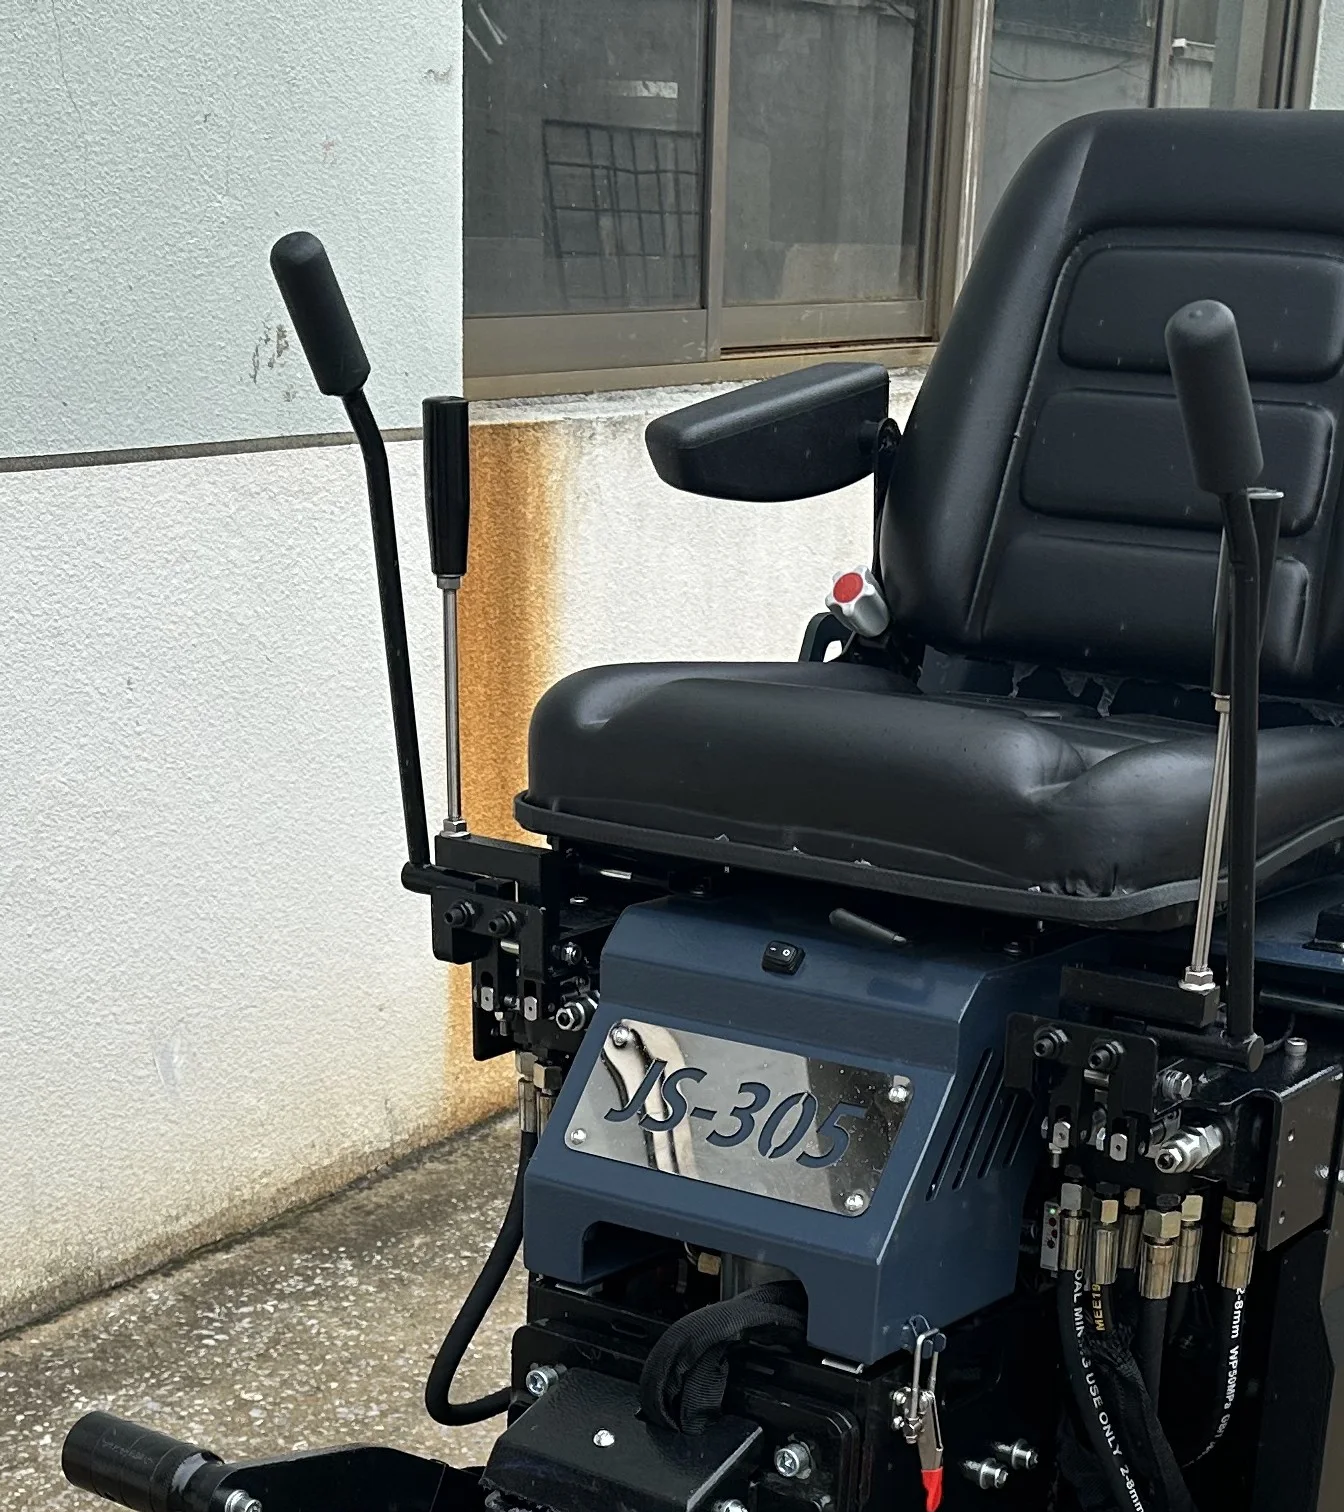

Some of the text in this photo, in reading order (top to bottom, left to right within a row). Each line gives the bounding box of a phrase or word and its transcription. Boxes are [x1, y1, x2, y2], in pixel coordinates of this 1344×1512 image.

[603, 1057, 868, 1169] JS-305
[1073, 1268, 1084, 1304] OAL
[1085, 1372, 1104, 1409] USE
[1098, 1411, 1123, 1456] ONLY
[1230, 1287, 1246, 1339] 2-8mm
